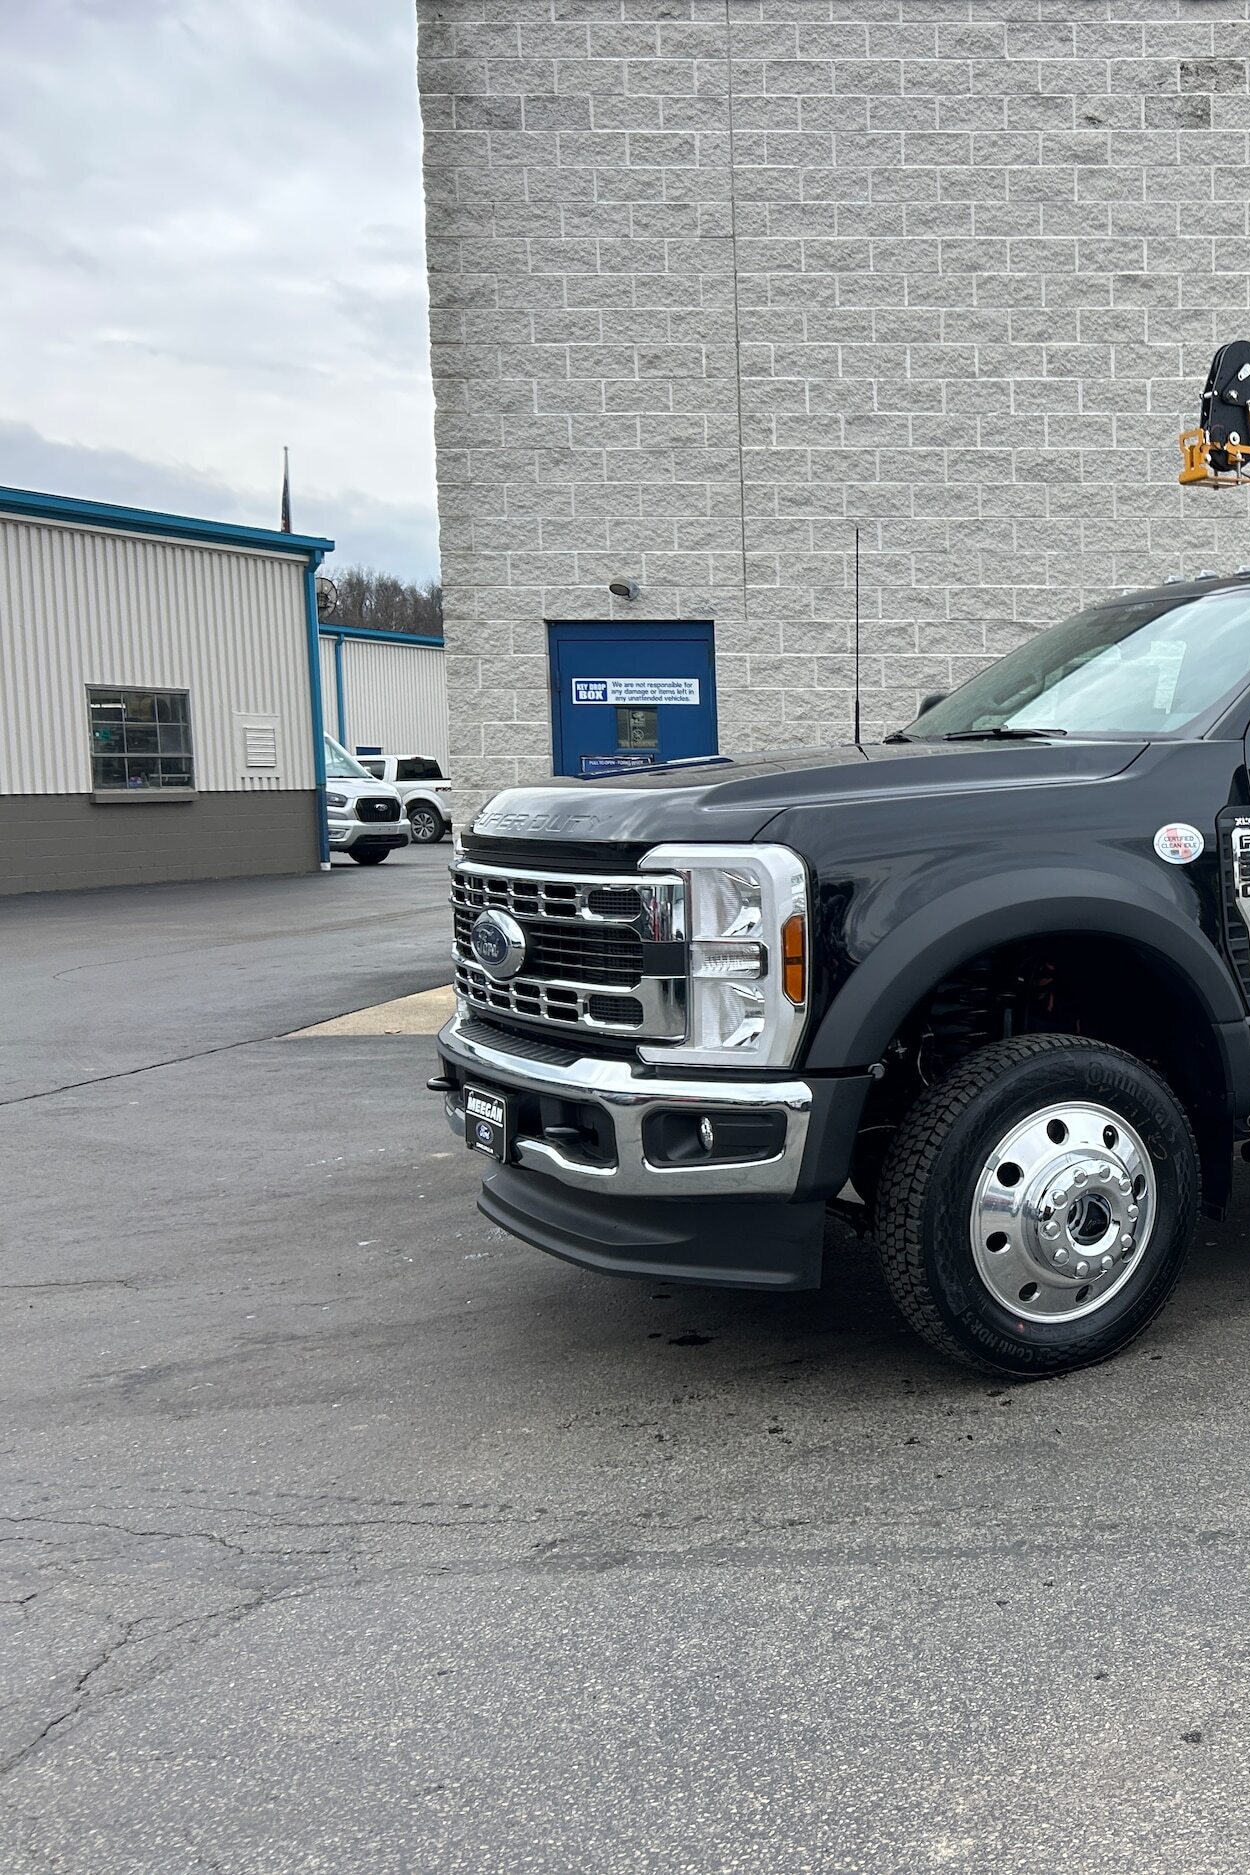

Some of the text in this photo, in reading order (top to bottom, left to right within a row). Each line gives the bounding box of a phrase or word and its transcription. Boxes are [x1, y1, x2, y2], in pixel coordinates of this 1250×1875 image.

[577, 683, 606, 691] KEY DROP
[647, 681, 682, 689] responsible
[579, 691, 603, 700] BOX
[467, 1096, 503, 1122] MEEGAN
